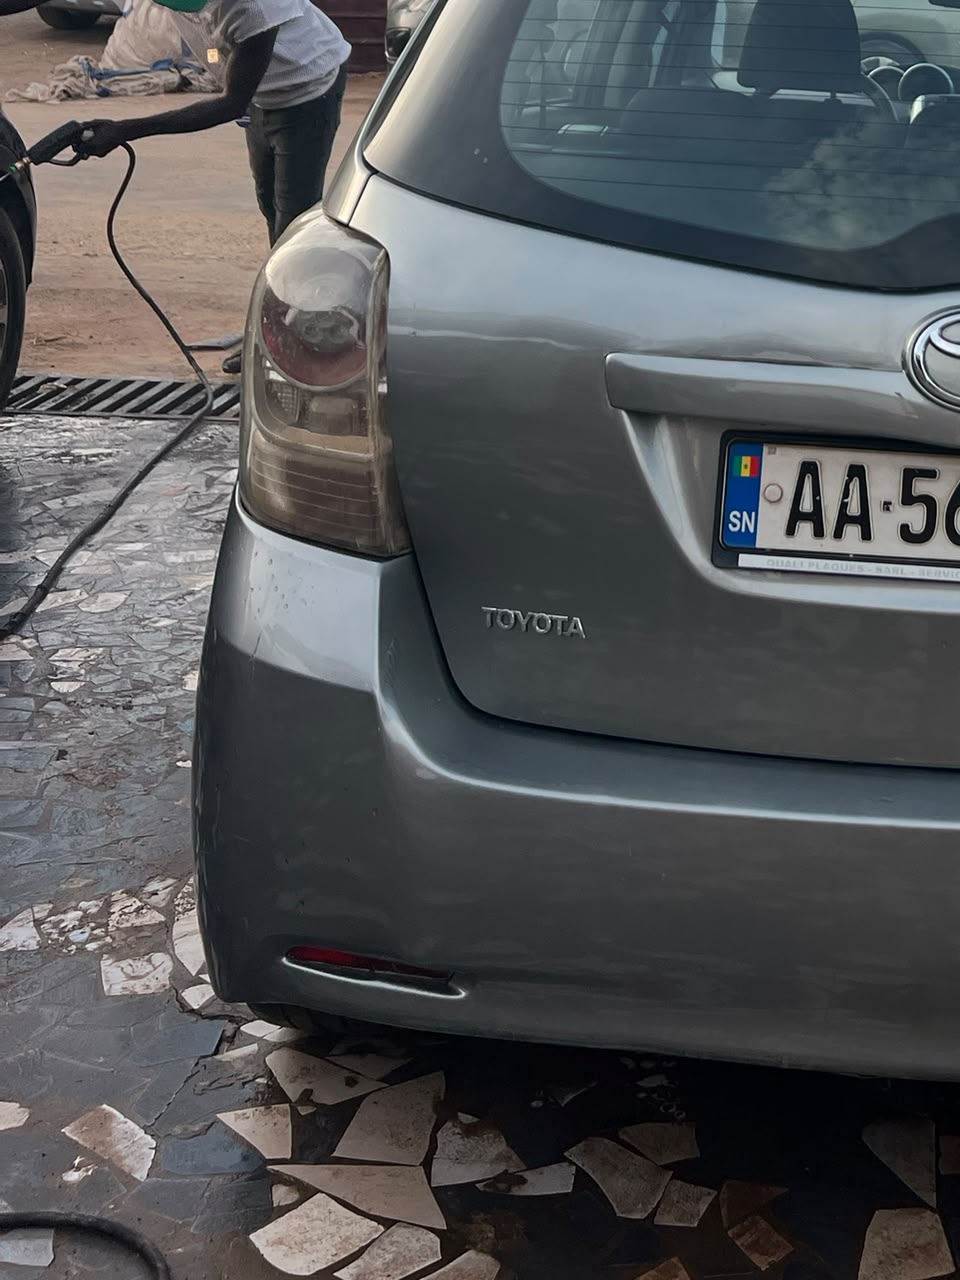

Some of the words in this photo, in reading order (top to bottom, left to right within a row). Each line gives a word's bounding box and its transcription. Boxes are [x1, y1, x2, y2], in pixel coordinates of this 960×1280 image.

[728, 510, 756, 534] SN
[808, 560, 865, 573] PLAQUES
[481, 606, 586, 639] TOYOTA
